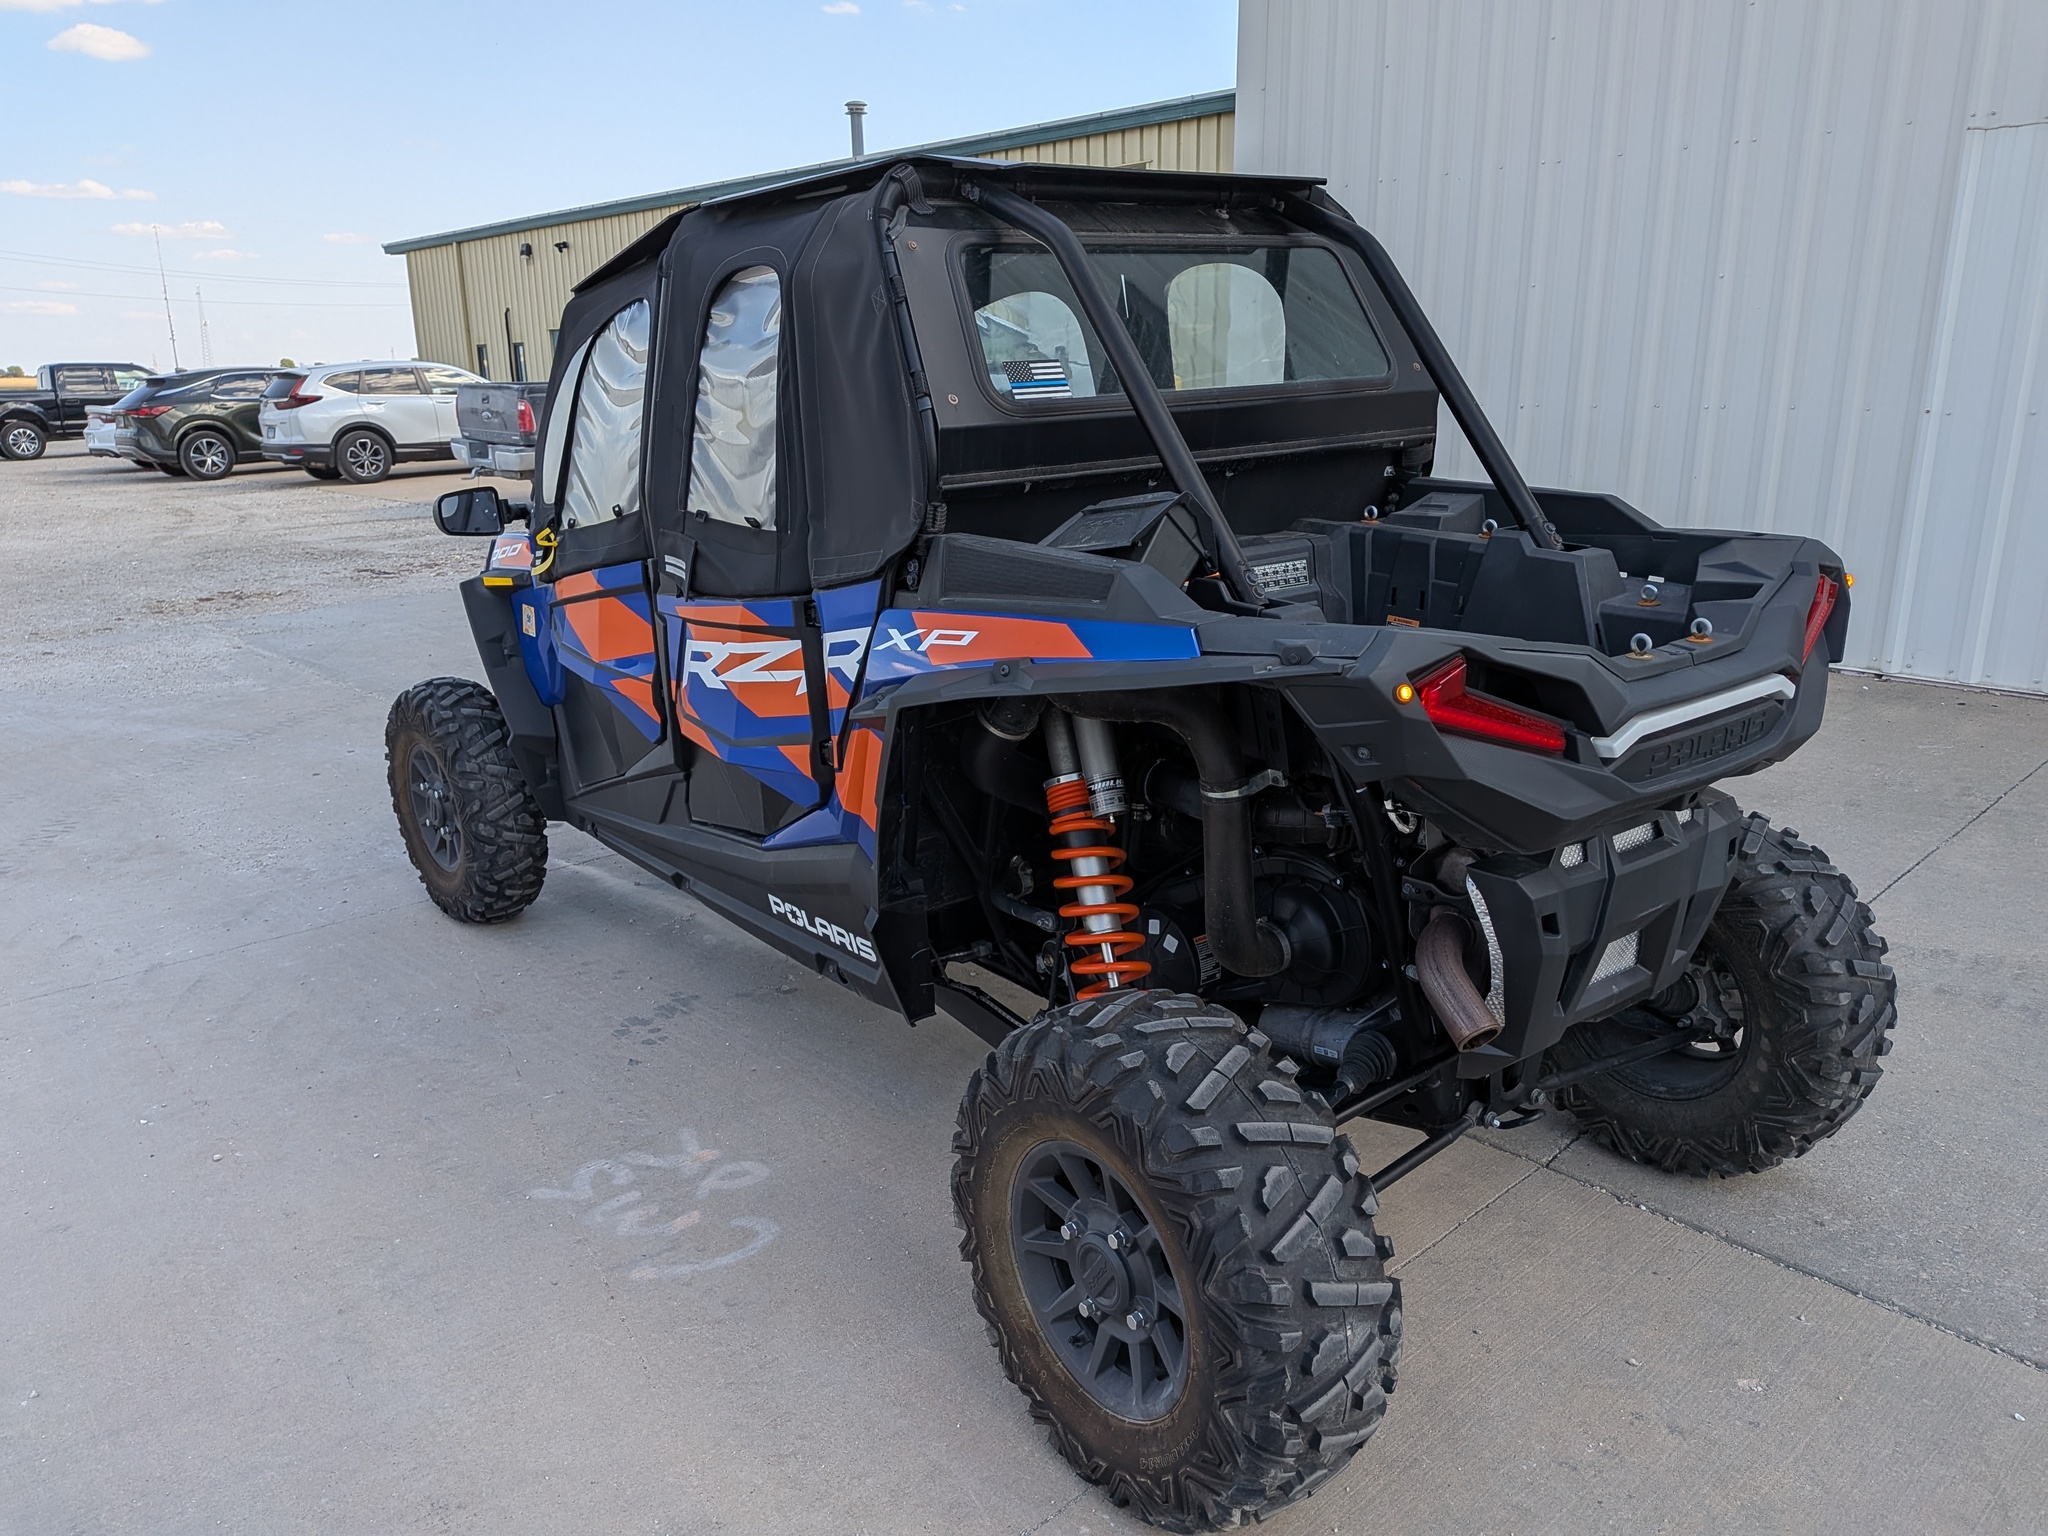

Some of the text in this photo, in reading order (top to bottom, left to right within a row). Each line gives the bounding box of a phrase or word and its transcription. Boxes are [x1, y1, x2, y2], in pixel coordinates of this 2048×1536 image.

[682, 626, 980, 696] RZR XP
[1647, 709, 1768, 775] POLARIS
[767, 893, 877, 963] POLARIS
